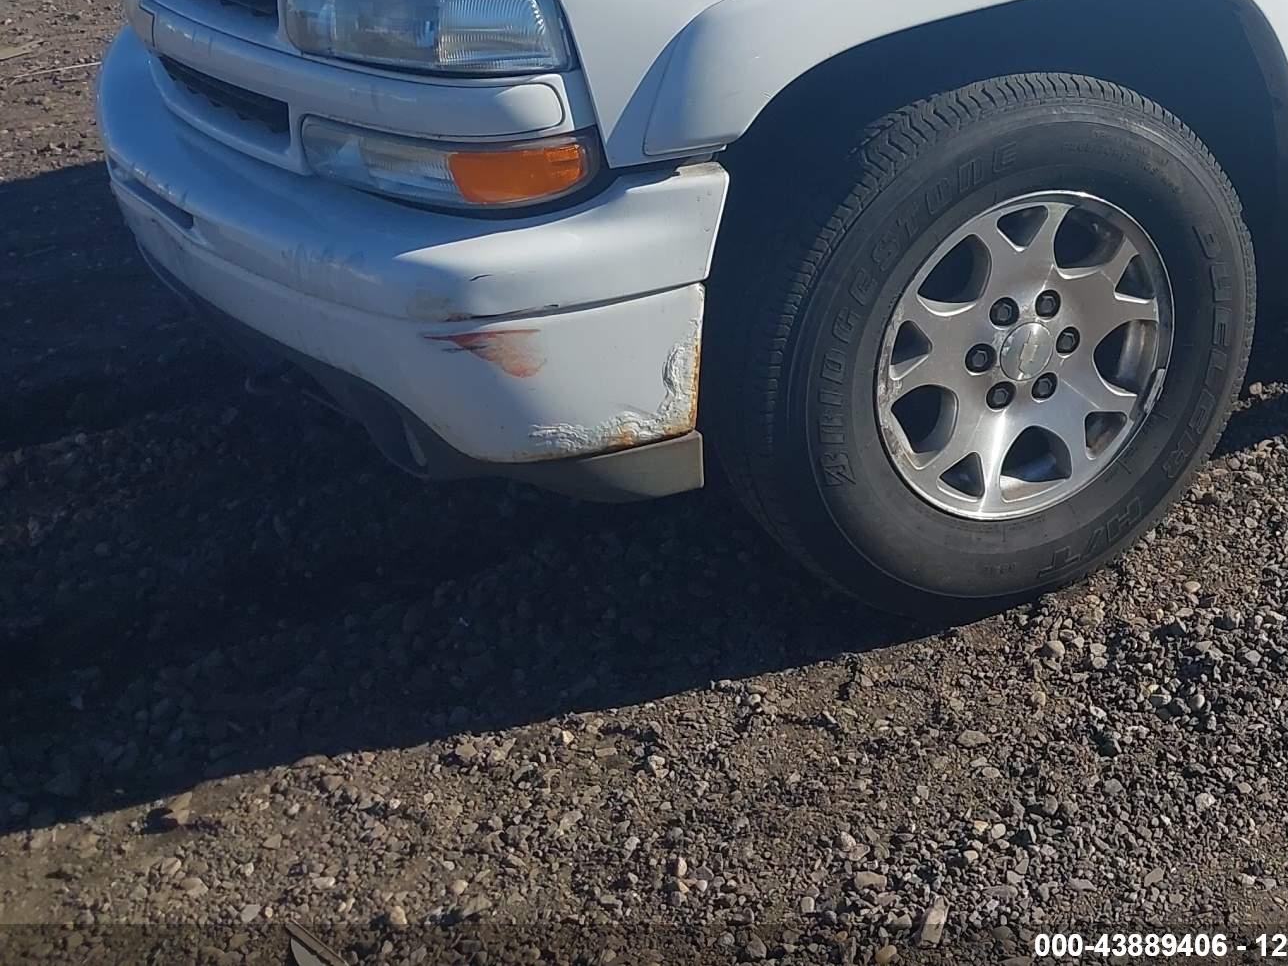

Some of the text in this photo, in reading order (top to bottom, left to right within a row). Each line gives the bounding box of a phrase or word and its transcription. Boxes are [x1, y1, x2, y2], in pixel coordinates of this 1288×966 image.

[815, 142, 1018, 486] BRIDGESTONE
[1037, 225, 1233, 579] DUELER H/T
